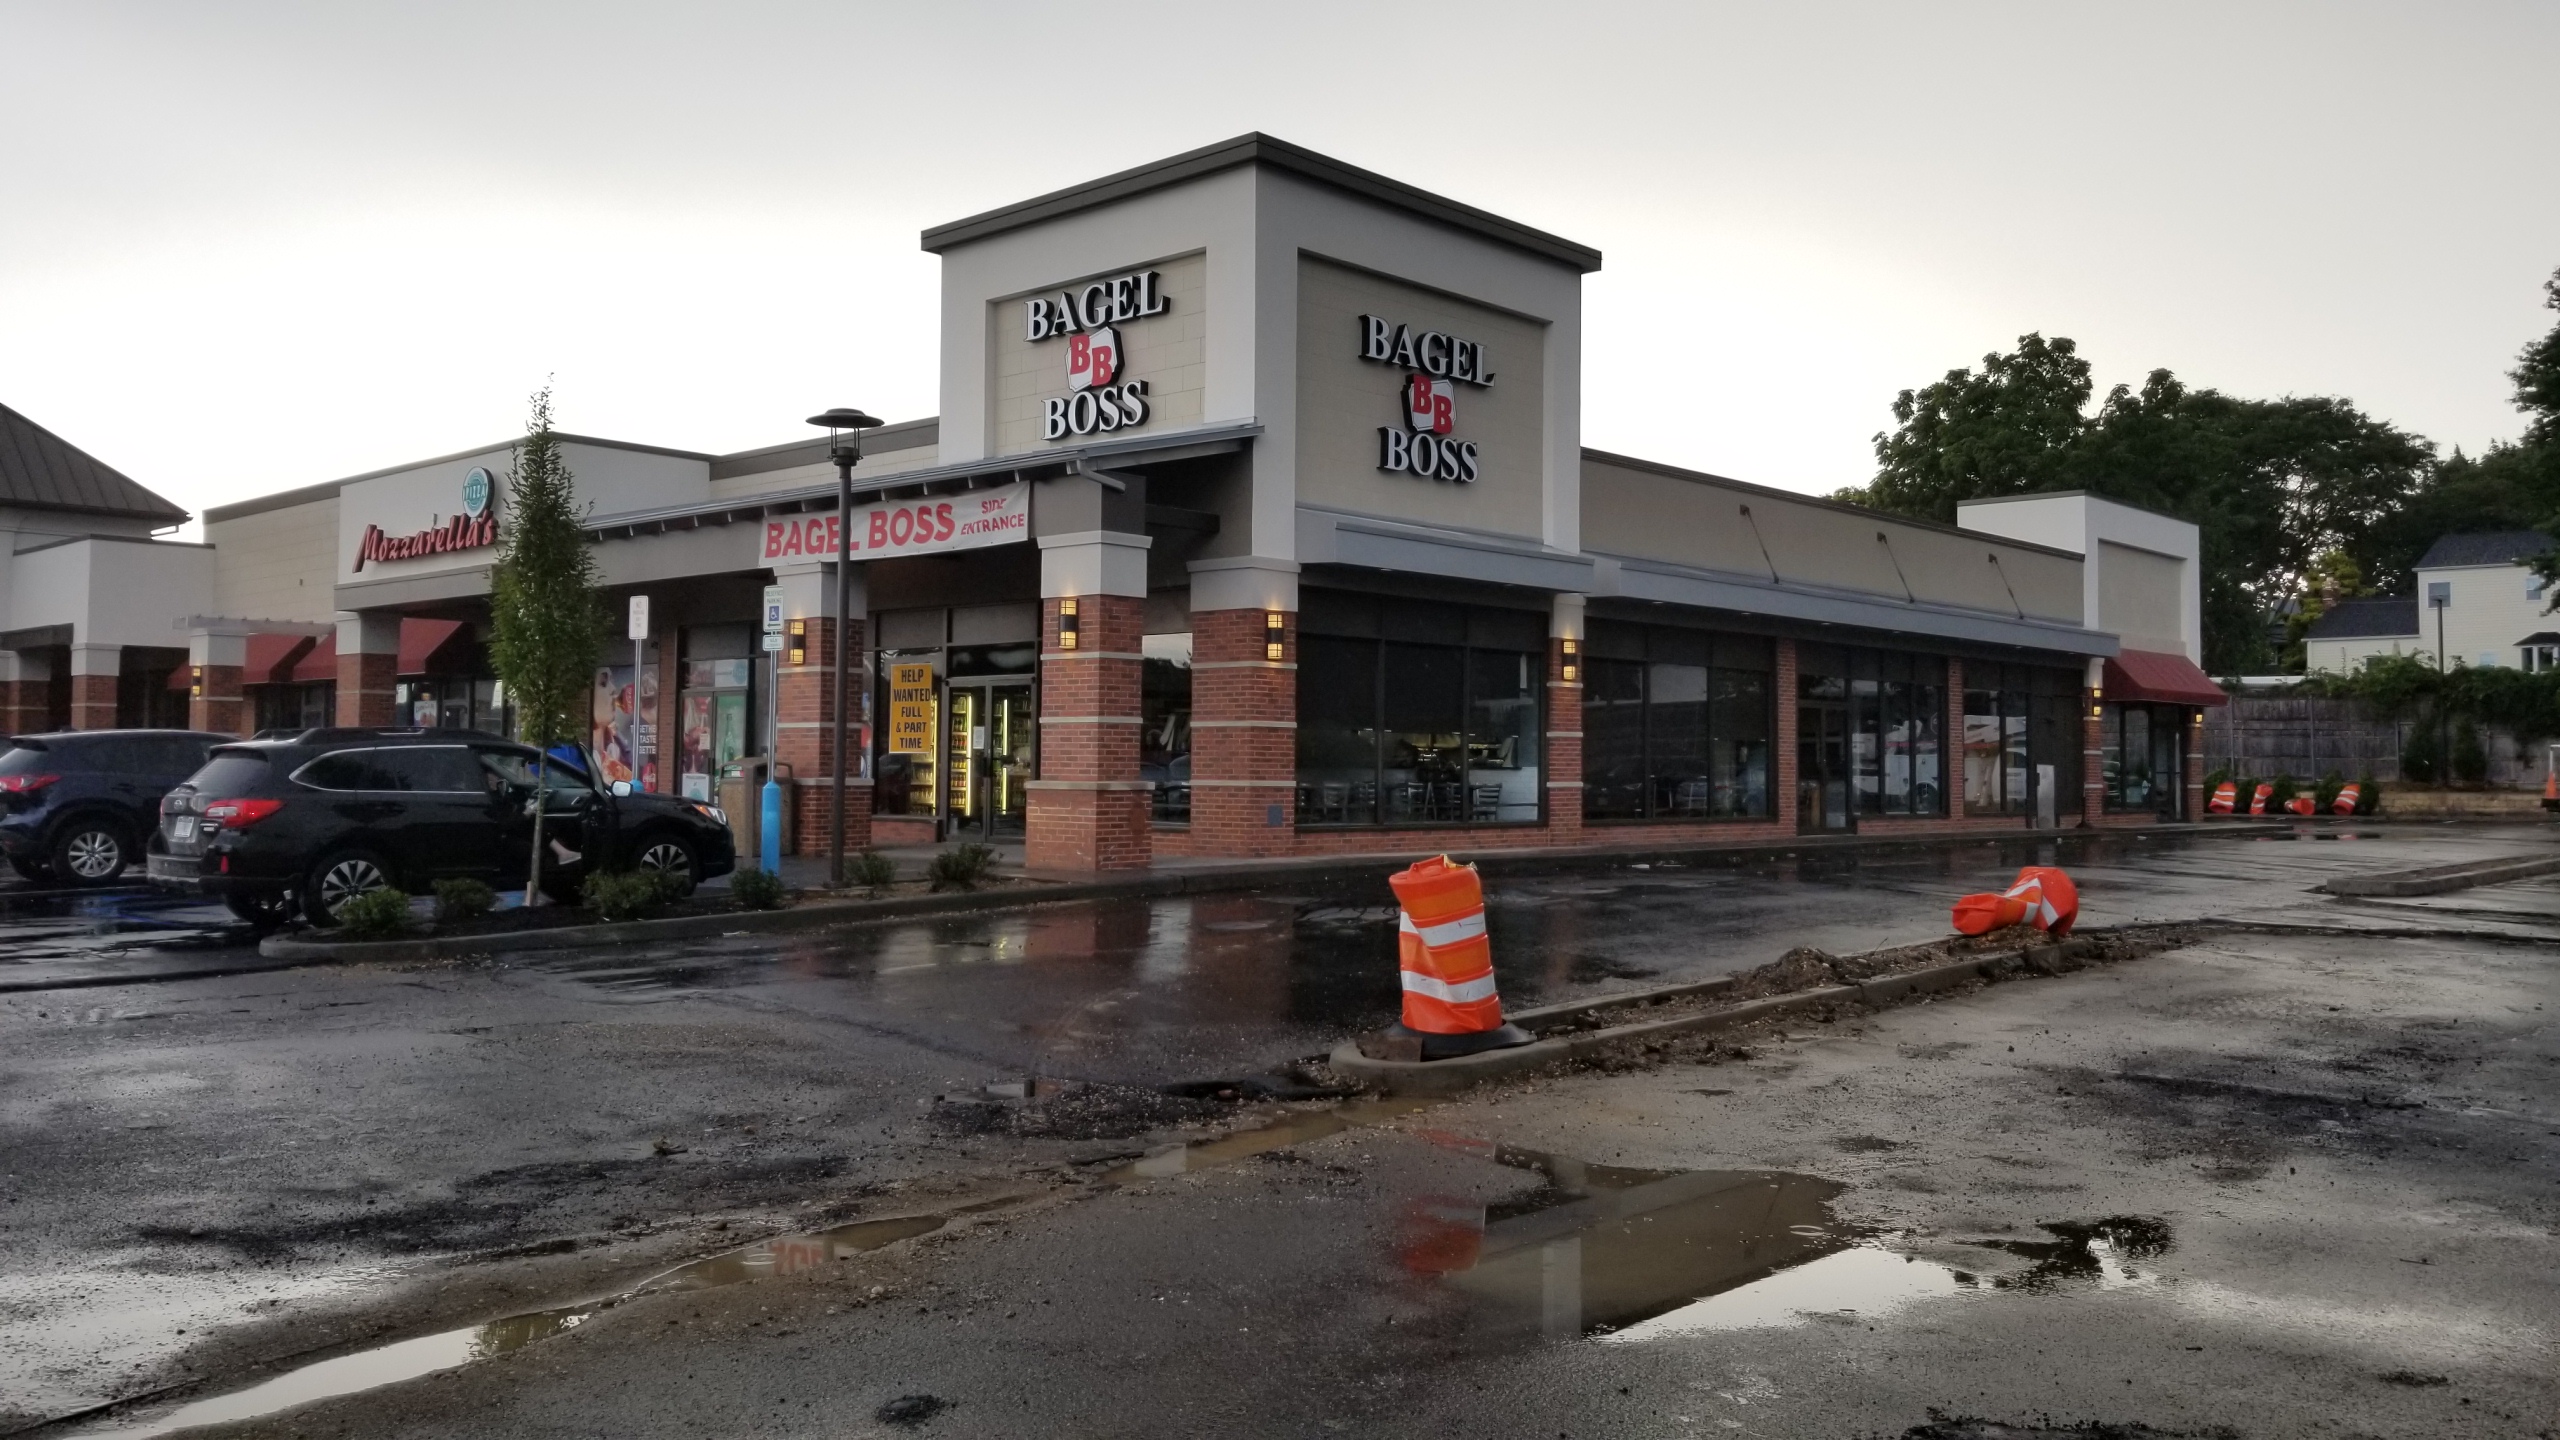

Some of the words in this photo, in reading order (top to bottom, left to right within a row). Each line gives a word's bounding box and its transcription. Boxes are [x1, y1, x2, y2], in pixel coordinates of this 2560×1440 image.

[1025, 271, 1171, 343] BAGEL
[1069, 335, 1113, 387] BB
[1358, 314, 1496, 387] BAGEL
[1041, 380, 1149, 440] BOSS
[1412, 374, 1453, 434] BB
[1377, 426, 1479, 483] BOSS
[352, 508, 499, 573] Mozzarella's
[765, 515, 860, 558] BAGE
[868, 503, 956, 548] BOSS
[960, 513, 1025, 536] ENTRANCE
[893, 688, 931, 702] WANTED
[901, 669, 924, 683] HELP
[896, 722, 902, 733] &
[904, 722, 927, 733] PART
[901, 706, 922, 718] FULL
[900, 738, 922, 749] TIME
